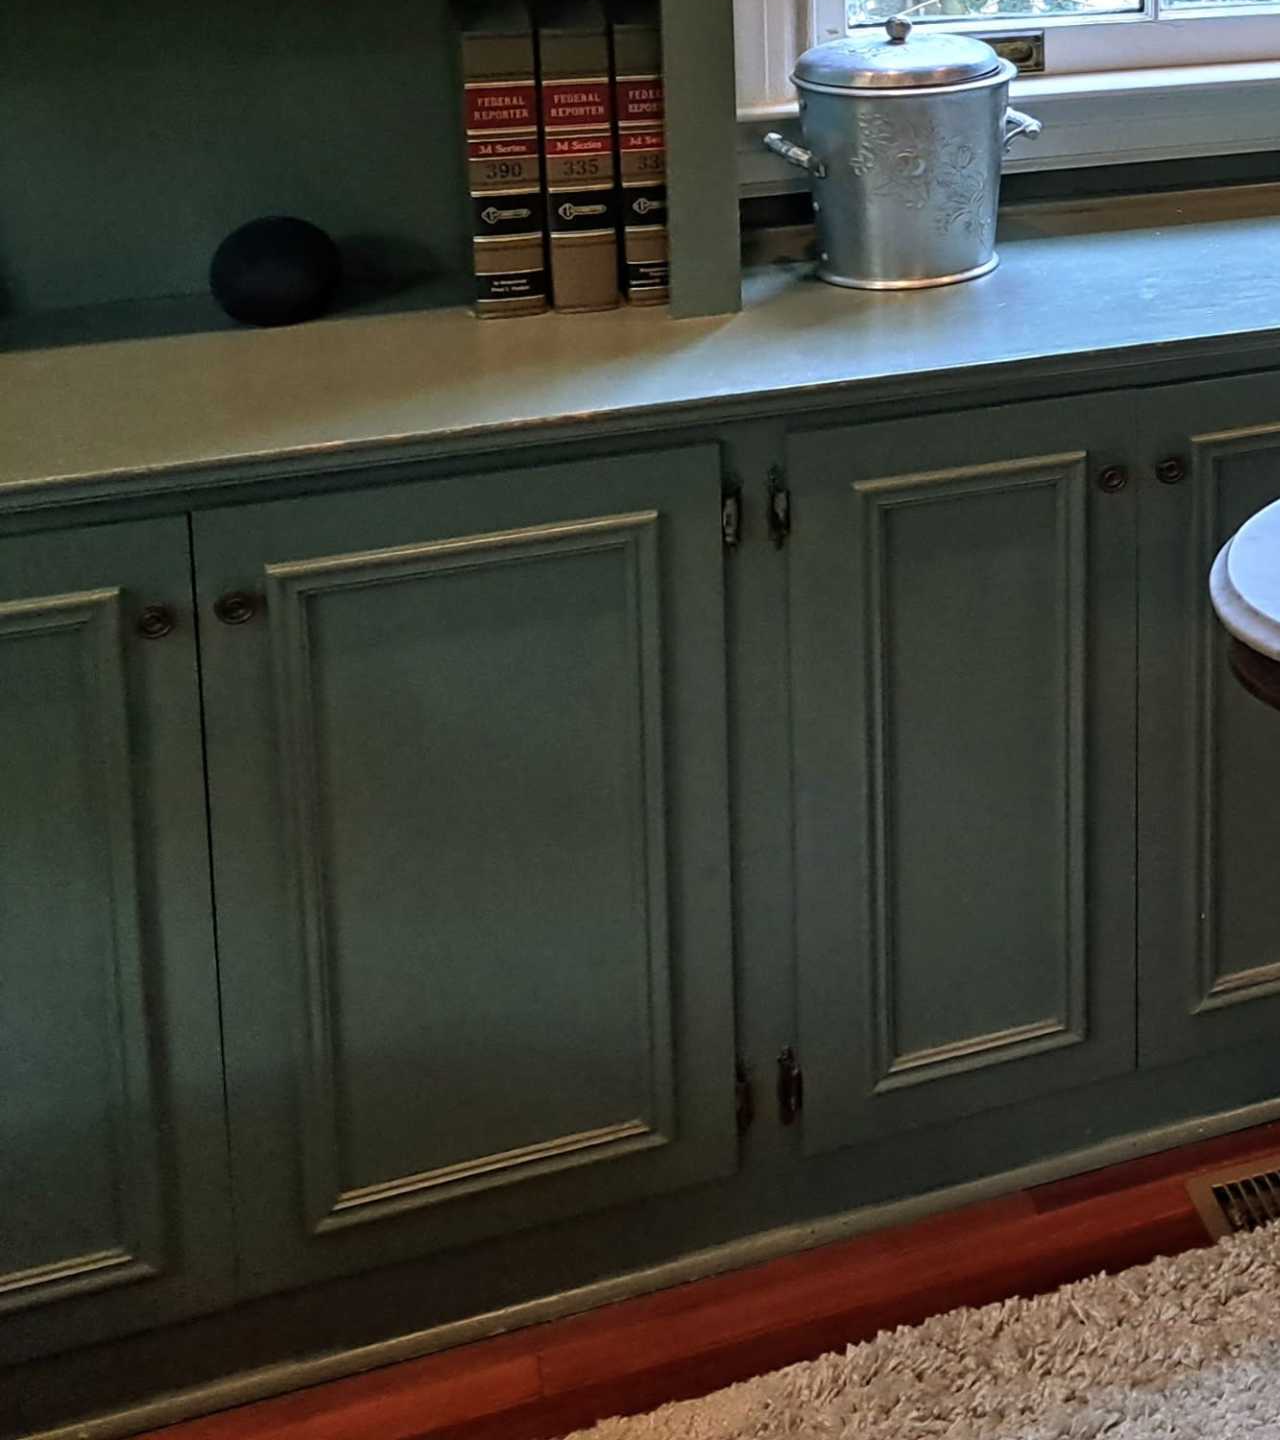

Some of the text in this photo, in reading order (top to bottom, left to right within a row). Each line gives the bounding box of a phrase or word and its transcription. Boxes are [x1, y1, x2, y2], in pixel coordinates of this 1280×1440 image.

[478, 96, 525, 106] FEDERAL
[554, 93, 600, 103] FEDERAL
[474, 108, 529, 121] REPORTER
[551, 105, 604, 117] REPORTER
[486, 162, 522, 180] 390
[563, 159, 599, 177] 335
